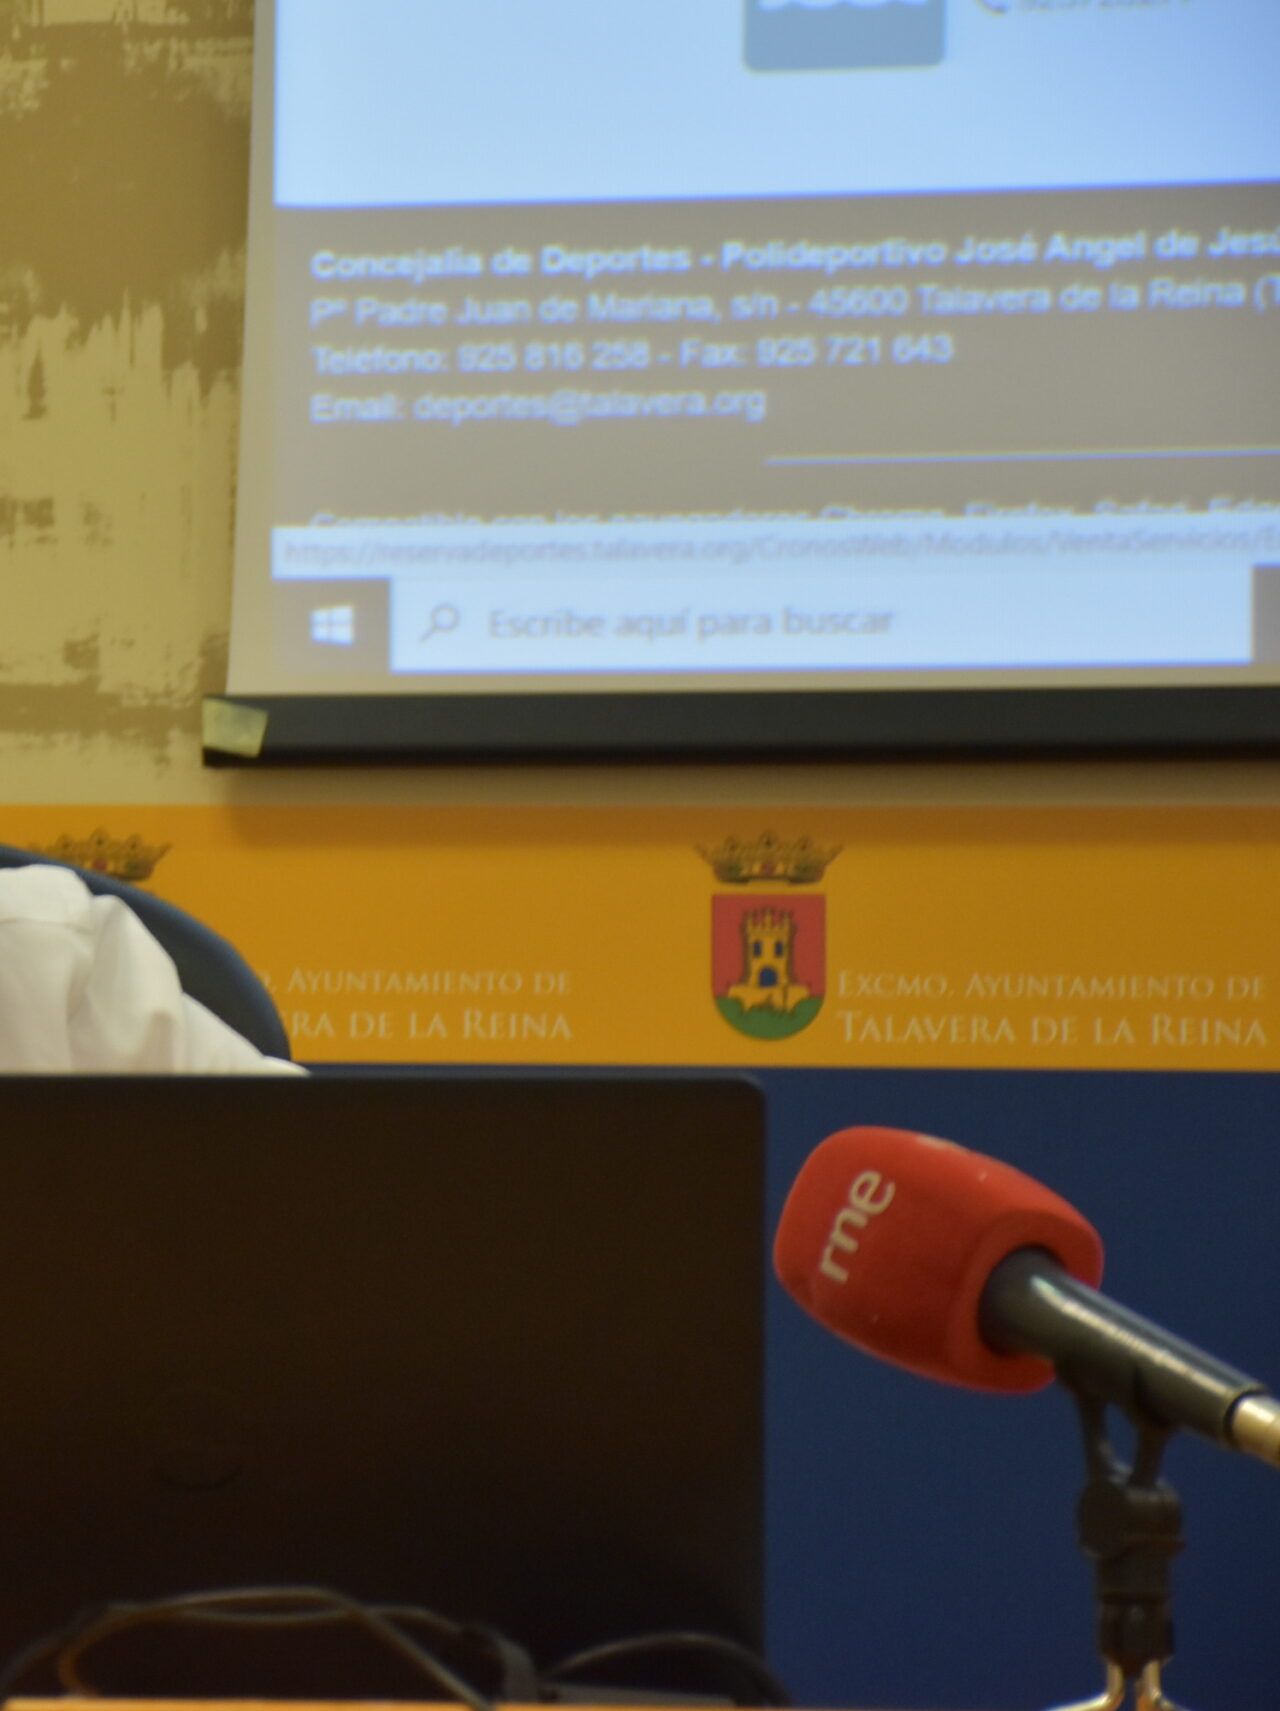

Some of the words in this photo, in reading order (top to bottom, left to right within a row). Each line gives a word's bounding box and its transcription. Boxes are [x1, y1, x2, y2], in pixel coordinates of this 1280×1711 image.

[311, 248, 482, 283] Concejalía
[491, 248, 532, 276] de
[541, 245, 692, 280] Deportes
[722, 238, 948, 277] Polideportivo
[954, 230, 1038, 266] José
[1154, 229, 1200, 261] de
[354, 296, 448, 327] Padre
[454, 294, 532, 325] Juan
[538, 294, 580, 324] de
[587, 292, 722, 324] Mariana,
[808, 284, 909, 318] 45600
[919, 281, 1051, 317] Talavera
[1058, 283, 1102, 313] de
[1108, 281, 1141, 311] la
[1147, 276, 1247, 310] Reina
[310, 343, 448, 376] Teléfono:
[457, 341, 518, 372] 925
[524, 339, 585, 372] 816
[591, 338, 651, 370] 258
[680, 337, 747, 369] Fax:
[756, 334, 817, 367] 925
[826, 332, 882, 366] 721
[891, 332, 955, 364] 643
[309, 391, 404, 423] Email:
[412, 387, 767, 428] deportes@talavera.org
[488, 608, 605, 640] Escribe
[613, 605, 688, 643] aquí
[697, 610, 773, 643] para
[782, 605, 895, 637] buscar
[287, 968, 522, 995] AYUNTAMIENTO
[532, 971, 573, 996] DE
[838, 970, 954, 999] EXCMO.
[965, 970, 1215, 999] AYUNTAMIENTO
[1225, 973, 1266, 1000] DE
[349, 1010, 395, 1040] DE
[408, 1009, 449, 1041] LA
[461, 1009, 574, 1042] REINA
[836, 1009, 1016, 1045] TALAVERA
[1030, 1012, 1079, 1046] DE
[1093, 1013, 1136, 1046] LA
[1151, 1012, 1268, 1048] REINA
[819, 1168, 897, 1284] rne
